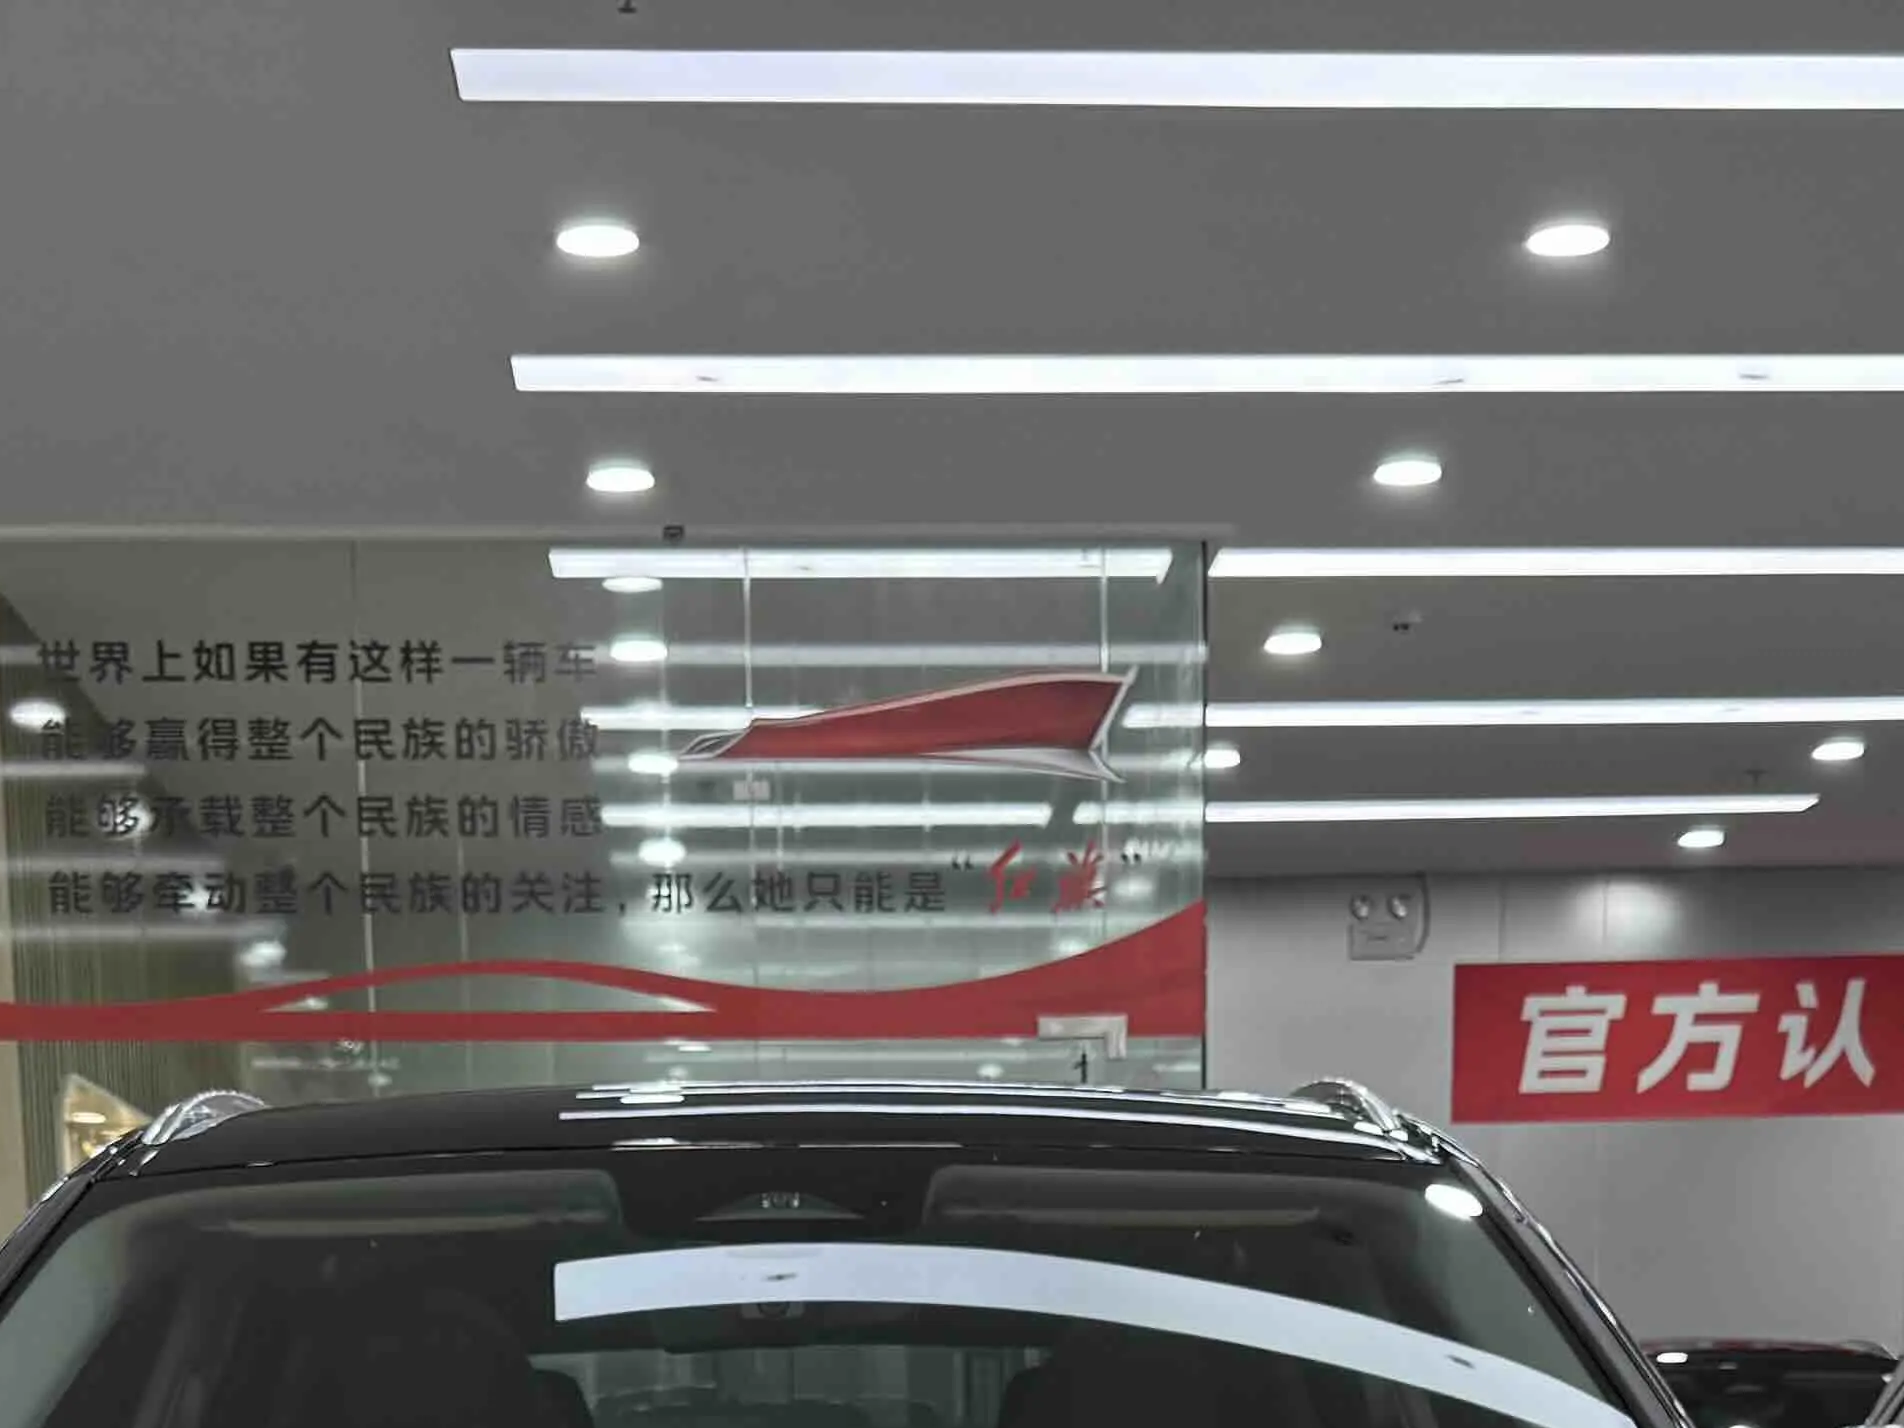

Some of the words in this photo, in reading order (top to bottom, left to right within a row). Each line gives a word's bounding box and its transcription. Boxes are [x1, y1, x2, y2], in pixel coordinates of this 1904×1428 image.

[37, 639, 597, 685] 世界上如果有这样一辆车
[41, 715, 598, 762] 能够赢得整个民族的骄傲
[46, 795, 605, 840] 能够承载整个民族的情感
